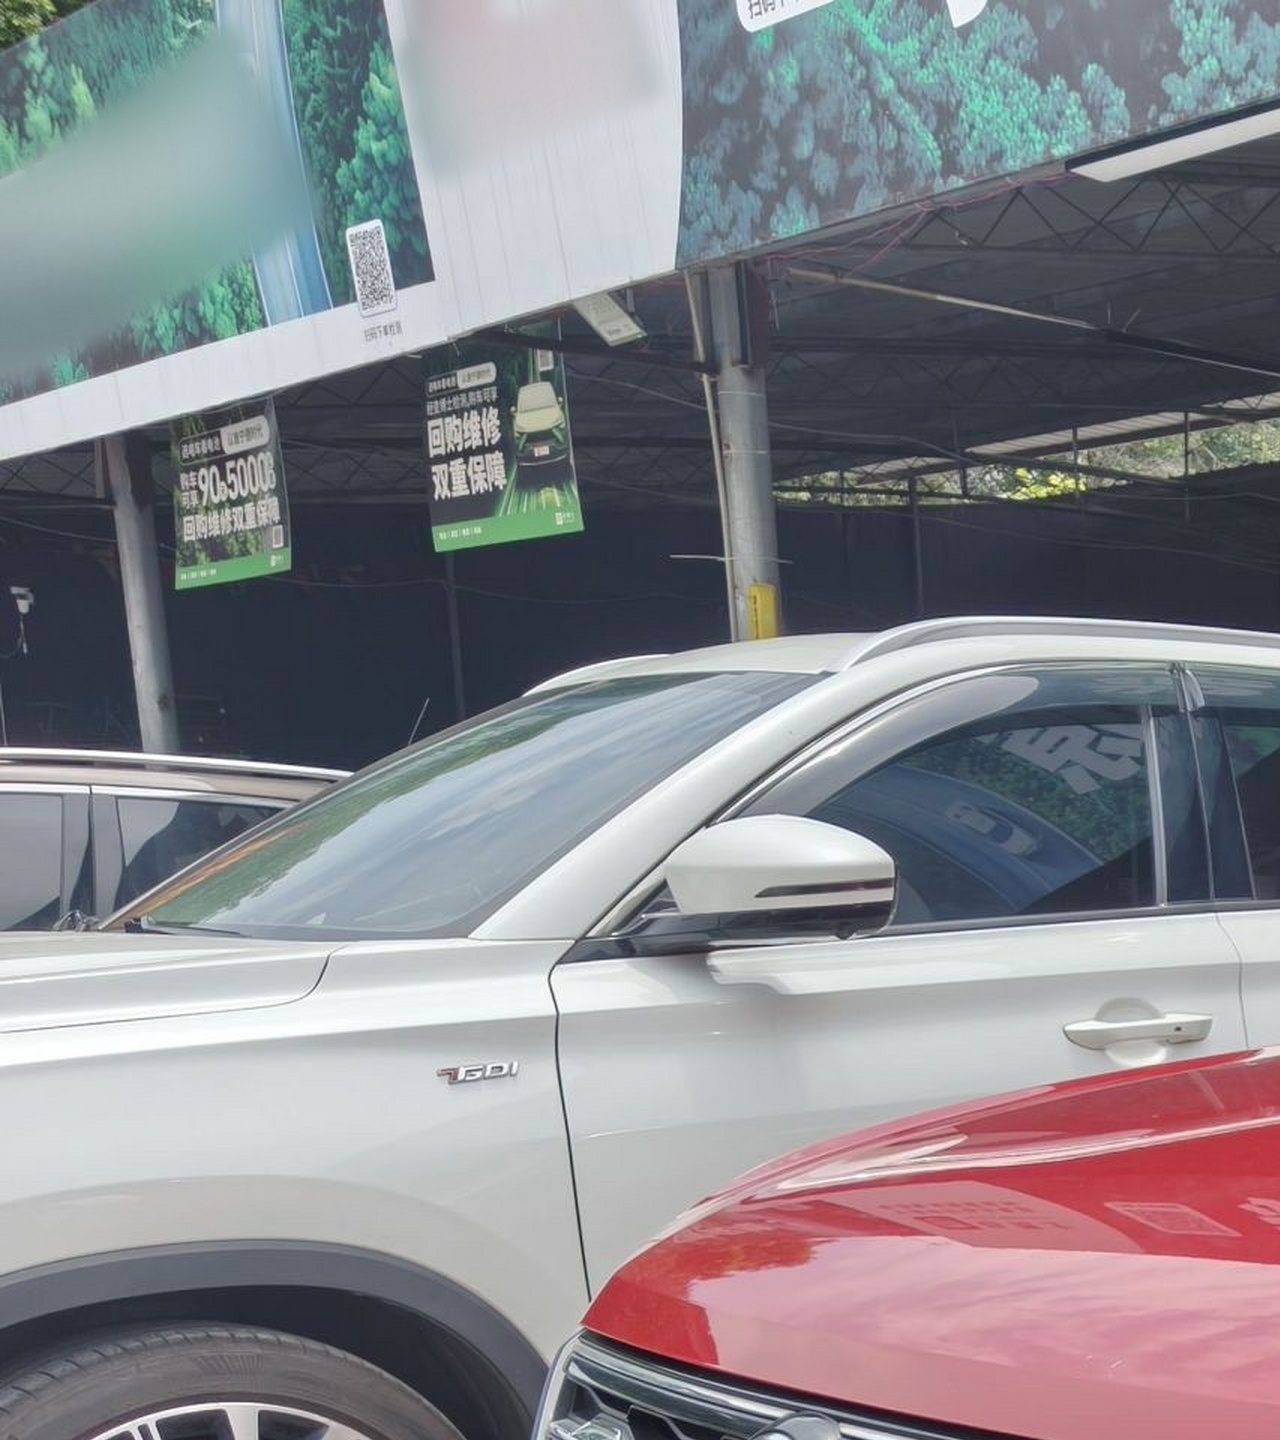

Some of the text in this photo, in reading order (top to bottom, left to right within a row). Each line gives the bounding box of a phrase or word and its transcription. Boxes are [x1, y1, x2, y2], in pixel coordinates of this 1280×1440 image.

[428, 406, 501, 458] 回购维修
[432, 451, 507, 500] 双重保障
[183, 496, 280, 542] 回购维修双重保障
